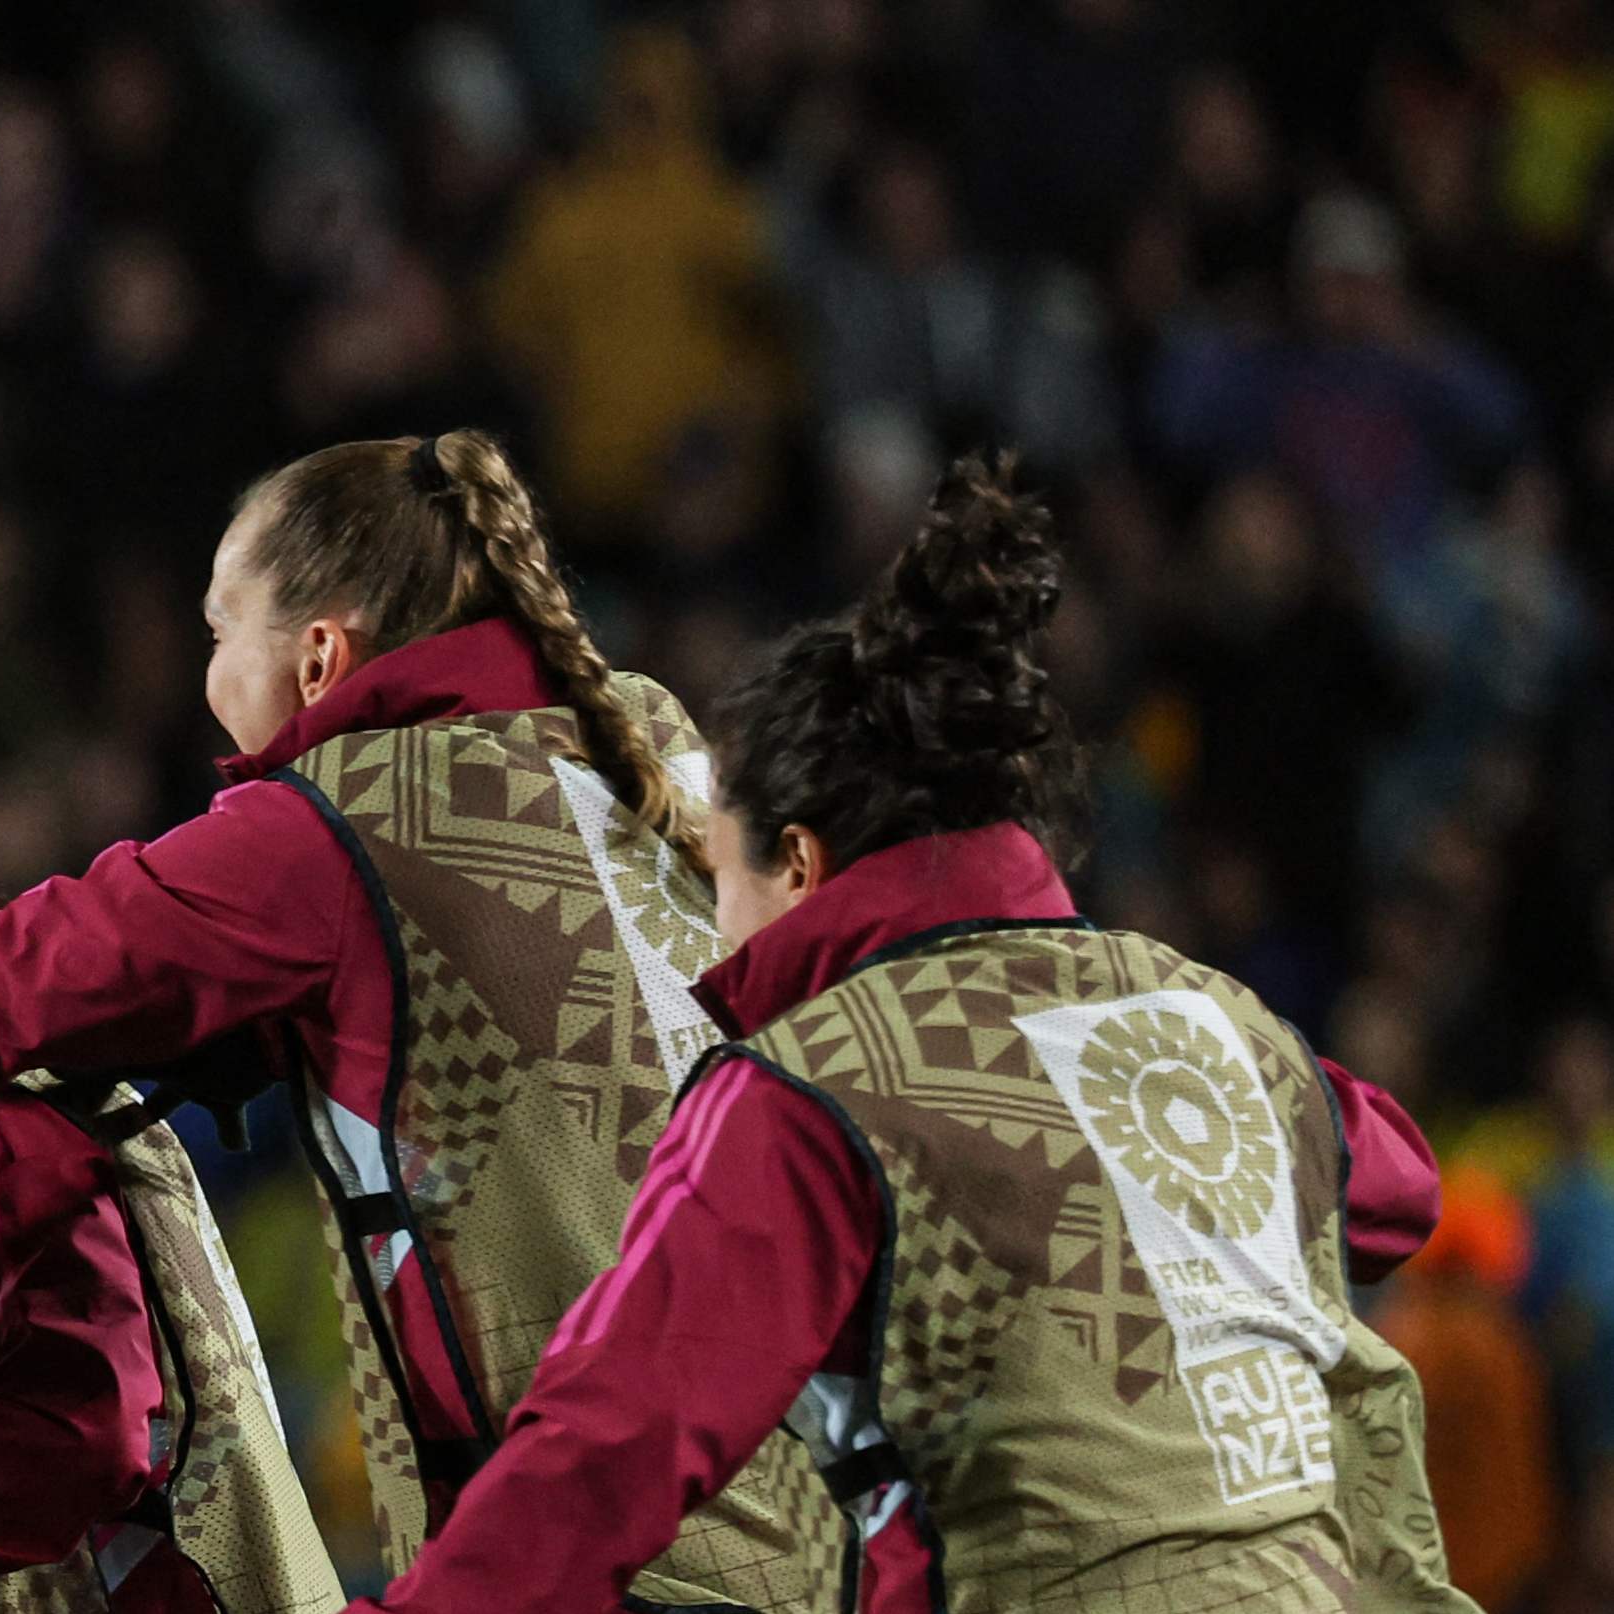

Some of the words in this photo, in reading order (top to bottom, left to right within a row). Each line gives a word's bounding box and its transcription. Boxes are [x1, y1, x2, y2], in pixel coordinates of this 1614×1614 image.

[1157, 1258, 1225, 1290] FIFA
[1202, 1360, 1279, 1428] AU
[1219, 1417, 1296, 1486] NZ
